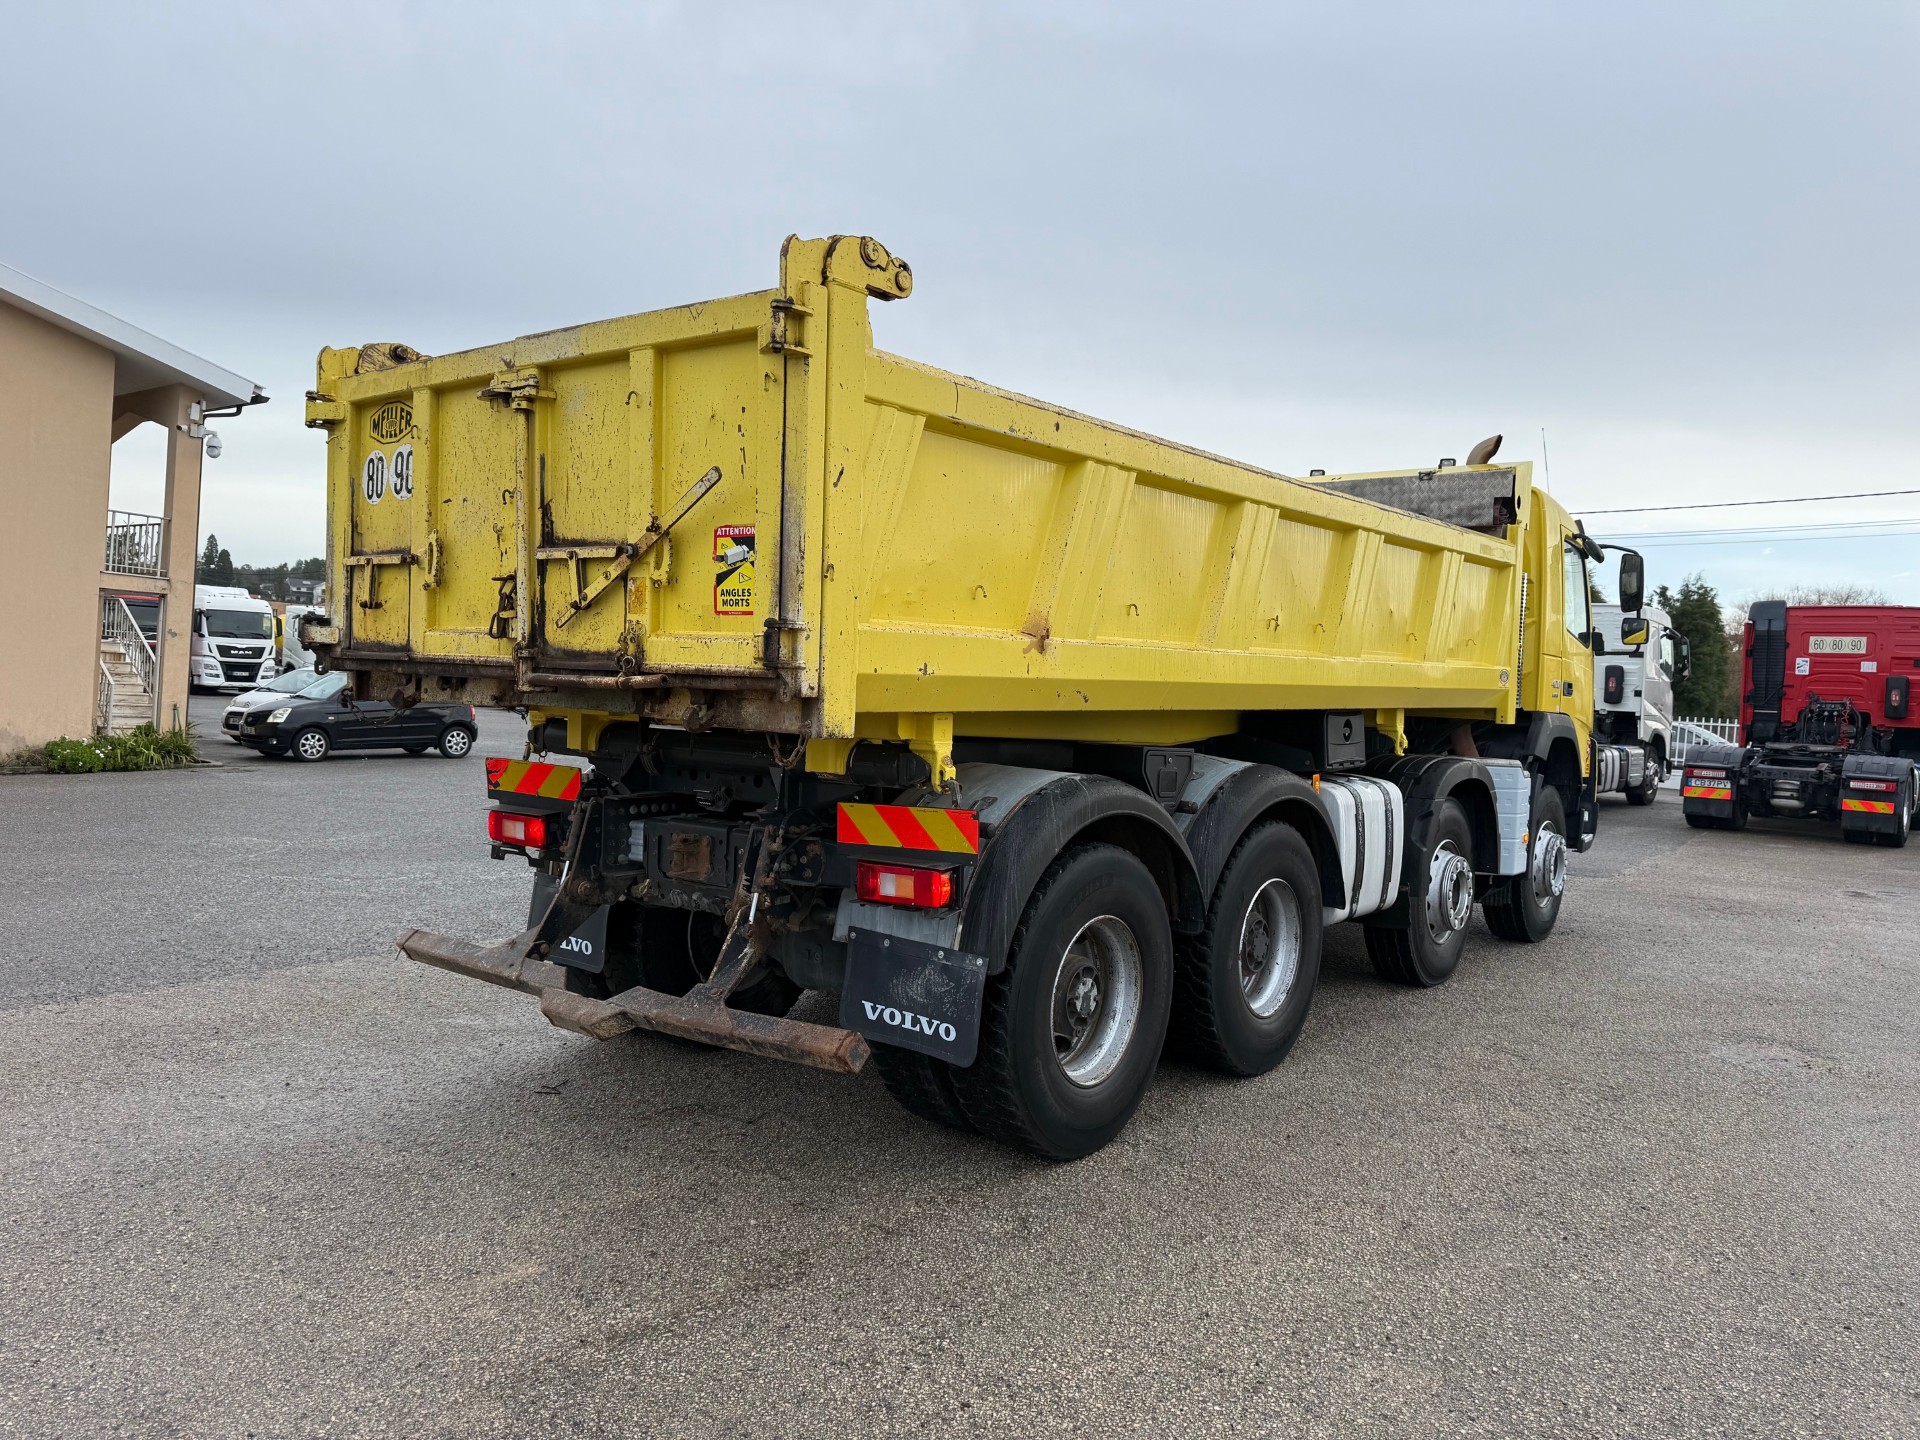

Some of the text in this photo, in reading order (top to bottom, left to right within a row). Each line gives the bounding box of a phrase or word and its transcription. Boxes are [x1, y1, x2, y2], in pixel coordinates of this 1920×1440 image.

[372, 406, 413, 440] MEILLER
[366, 455, 385, 501] 80
[720, 588, 752, 597] ANGLES
[722, 598, 750, 607] MORTS
[1813, 639, 1862, 651] 60 80 90
[559, 936, 593, 955] LVO
[861, 1000, 958, 1042] VOLVO
